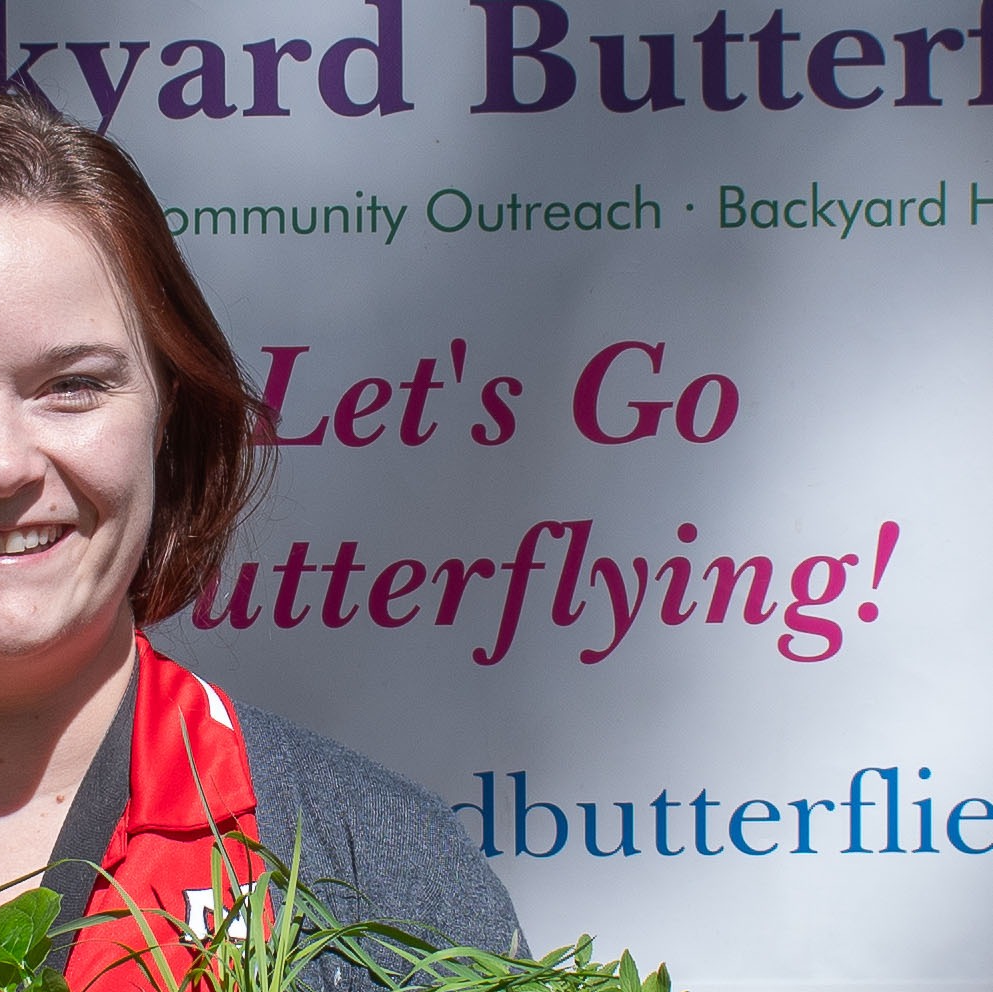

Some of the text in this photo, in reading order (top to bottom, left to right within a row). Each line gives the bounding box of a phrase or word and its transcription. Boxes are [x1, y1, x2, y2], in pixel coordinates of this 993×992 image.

[427, 184, 663, 233] Outreach
[720, 179, 948, 240] Backyard
[253, 339, 739, 447] Let's Go
[192, 521, 900, 665] utterflying!
